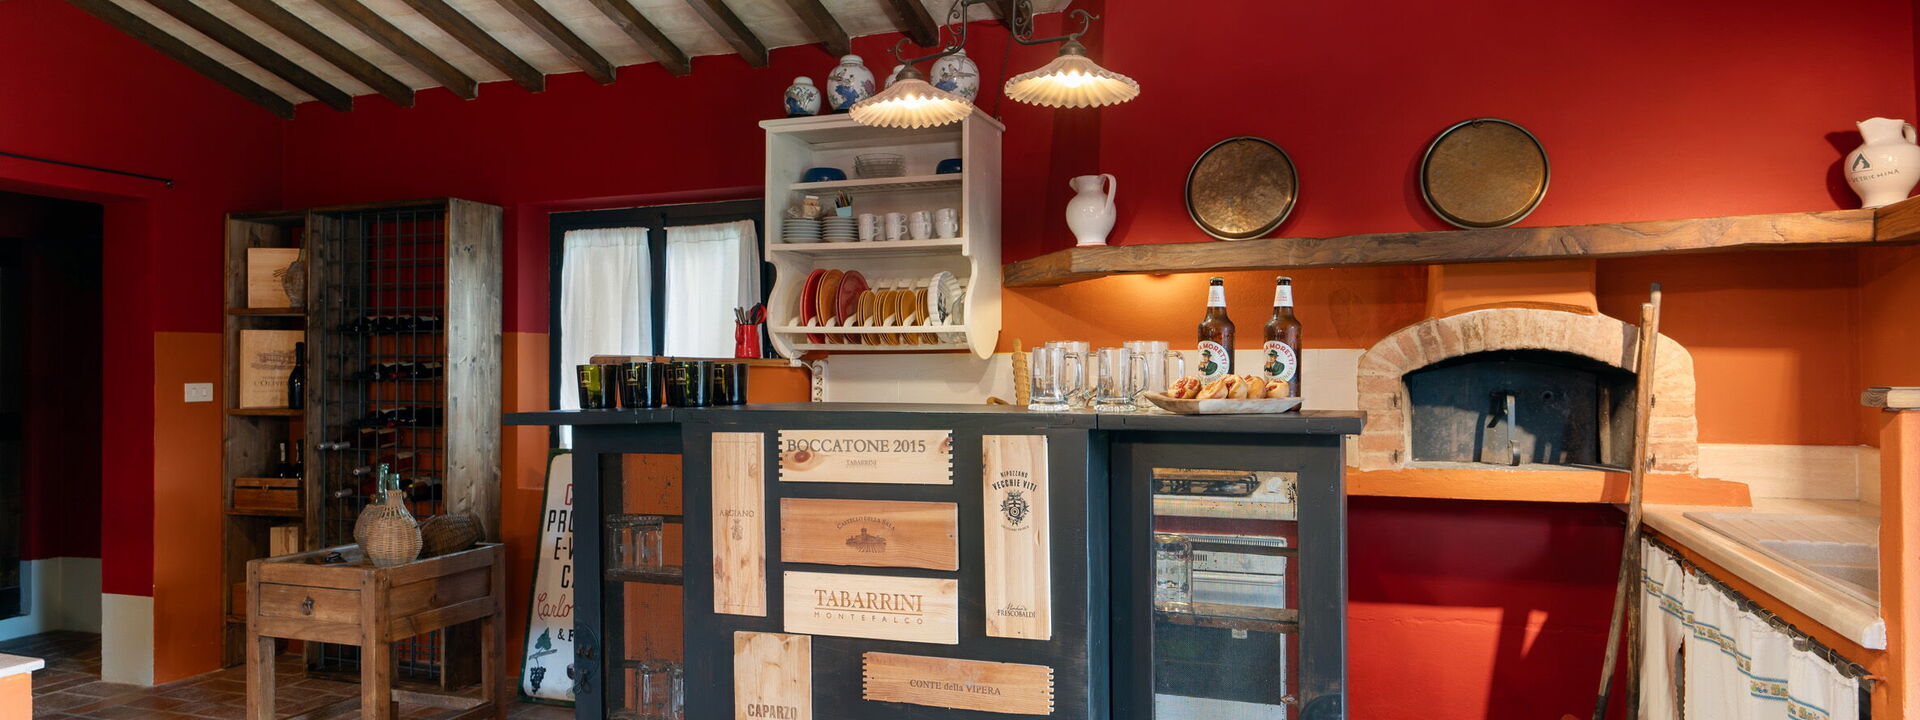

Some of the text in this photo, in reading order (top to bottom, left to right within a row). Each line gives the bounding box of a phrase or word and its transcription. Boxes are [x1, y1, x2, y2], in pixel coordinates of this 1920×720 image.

[1203, 343, 1228, 365] MORETTI
[1269, 343, 1294, 365] MORETTI
[786, 438, 926, 453] BOCCATONE 2015
[1000, 470, 1028, 478] NIPOZZANO
[992, 479, 1038, 492] VECCHIE VITI
[719, 509, 755, 517] ARGIANO
[537, 592, 574, 620] Carlo
[814, 589, 923, 612] TABARRINI
[814, 611, 924, 625] MONTEFALCO
[997, 609, 1036, 618] FRESCOBALDI
[557, 628, 565, 641] &
[909, 679, 1001, 696] CONTE della VIPERA
[747, 703, 797, 720] CAPARZO
